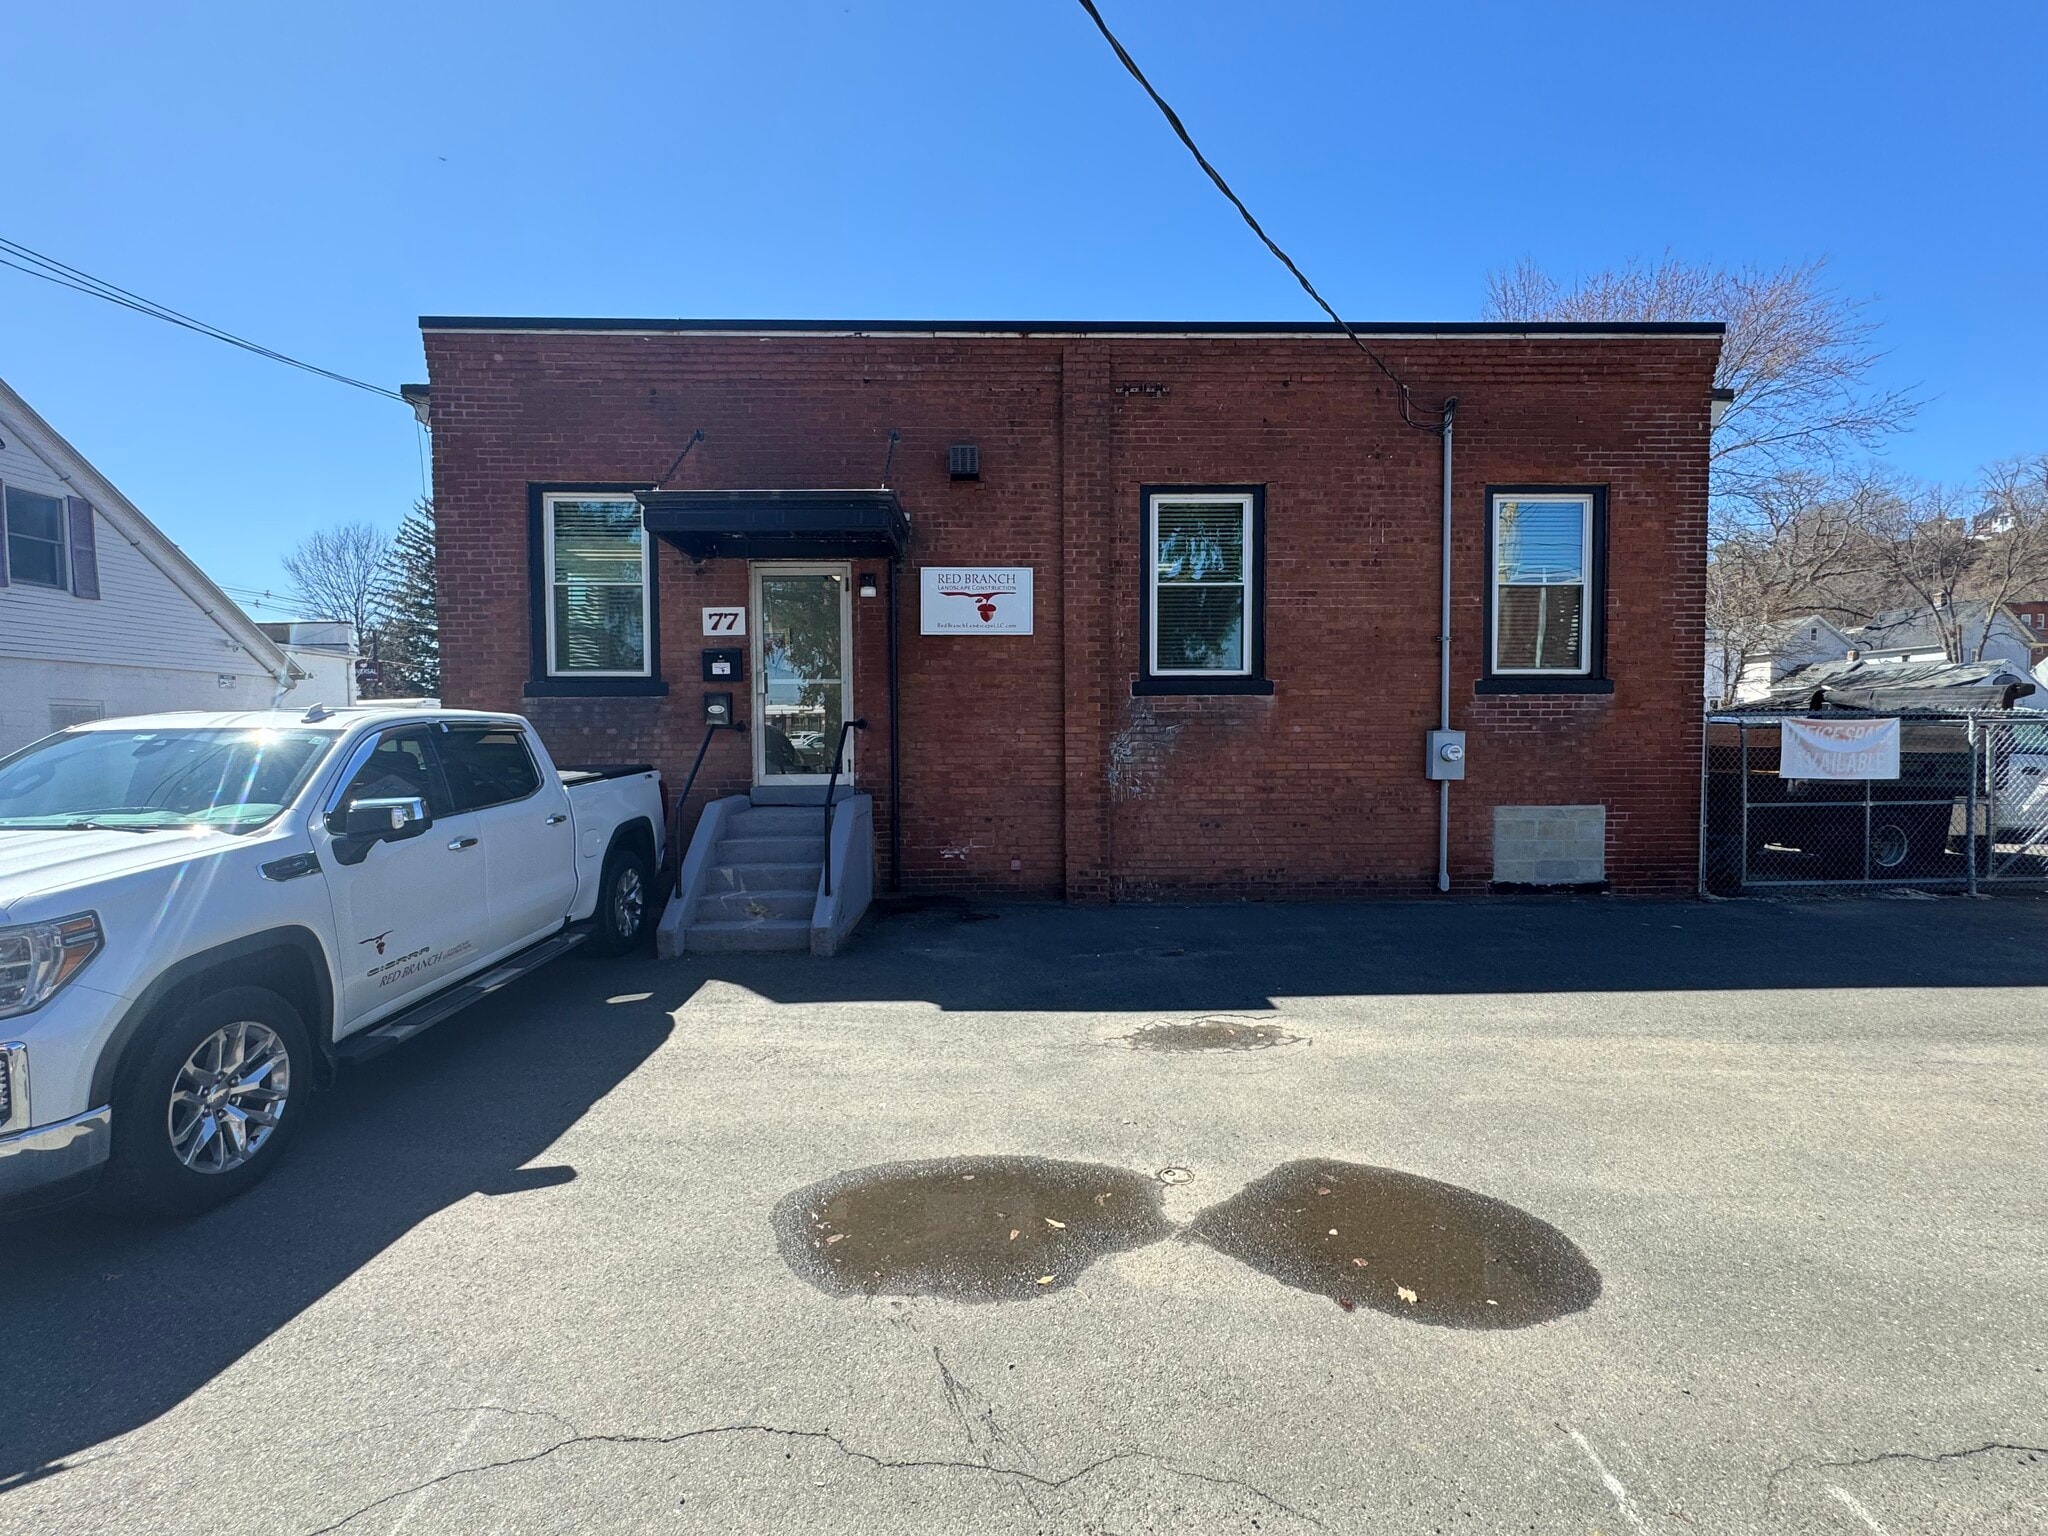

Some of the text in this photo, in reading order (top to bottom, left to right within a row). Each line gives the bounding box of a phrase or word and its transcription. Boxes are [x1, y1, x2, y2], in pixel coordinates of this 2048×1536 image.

[937, 573, 1016, 584] RED BRANCH
[708, 612, 739, 631] 77
[378, 951, 443, 988] RED BRANCH
